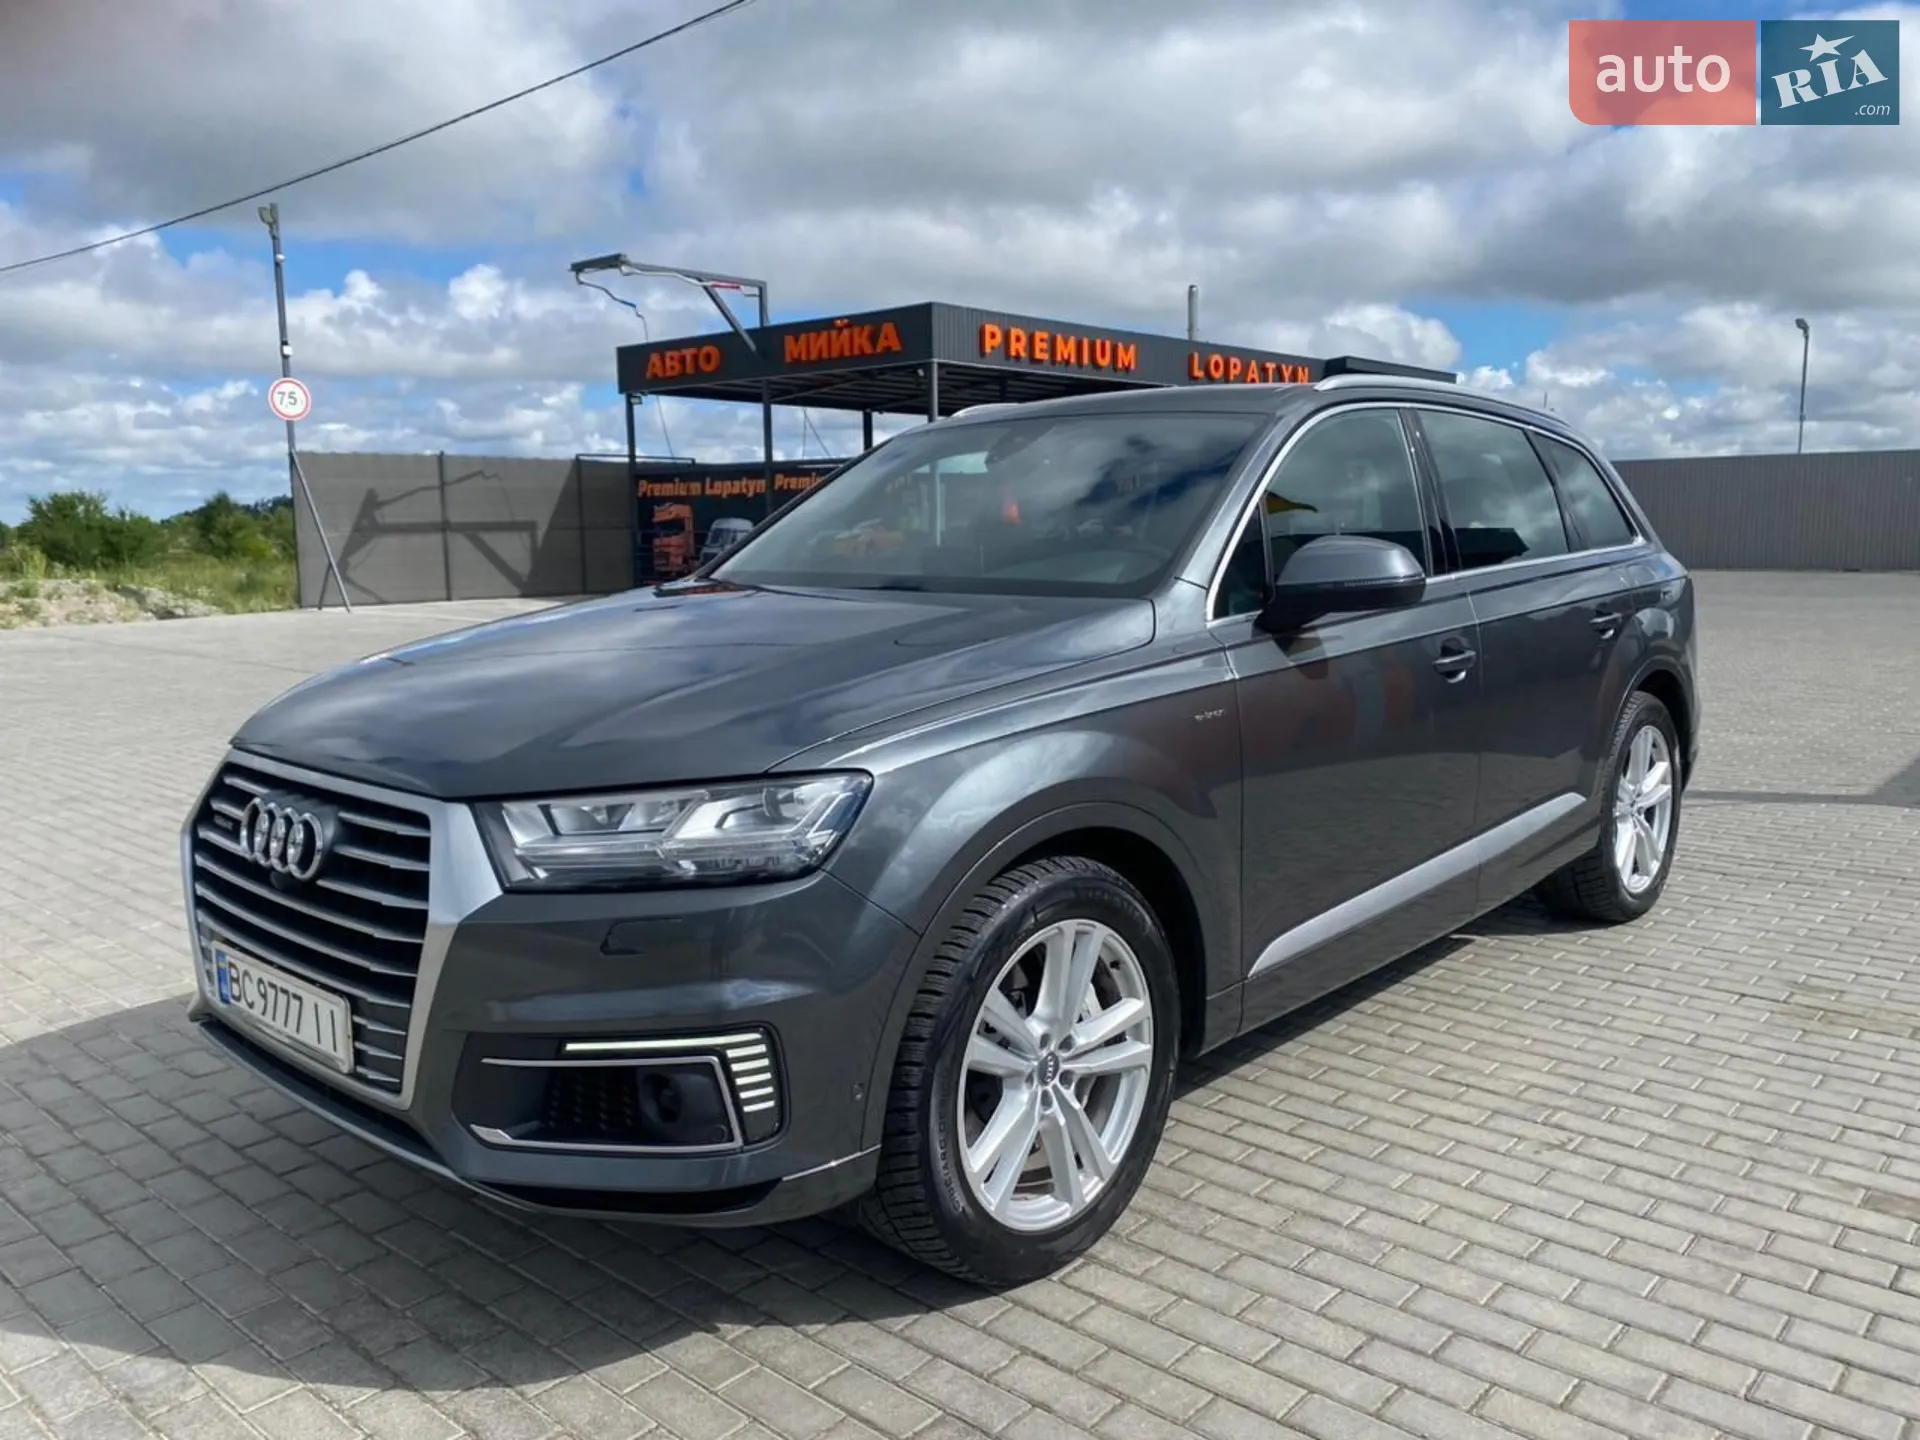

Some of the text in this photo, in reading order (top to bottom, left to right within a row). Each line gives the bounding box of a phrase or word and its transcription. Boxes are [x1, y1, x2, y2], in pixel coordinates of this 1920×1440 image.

[645, 319, 901, 380] АВТО МИЙКА
[979, 323, 1311, 384] PREMIUM LOPATYN
[638, 477, 702, 497] Premium
[704, 477, 767, 498] Lopatyn
